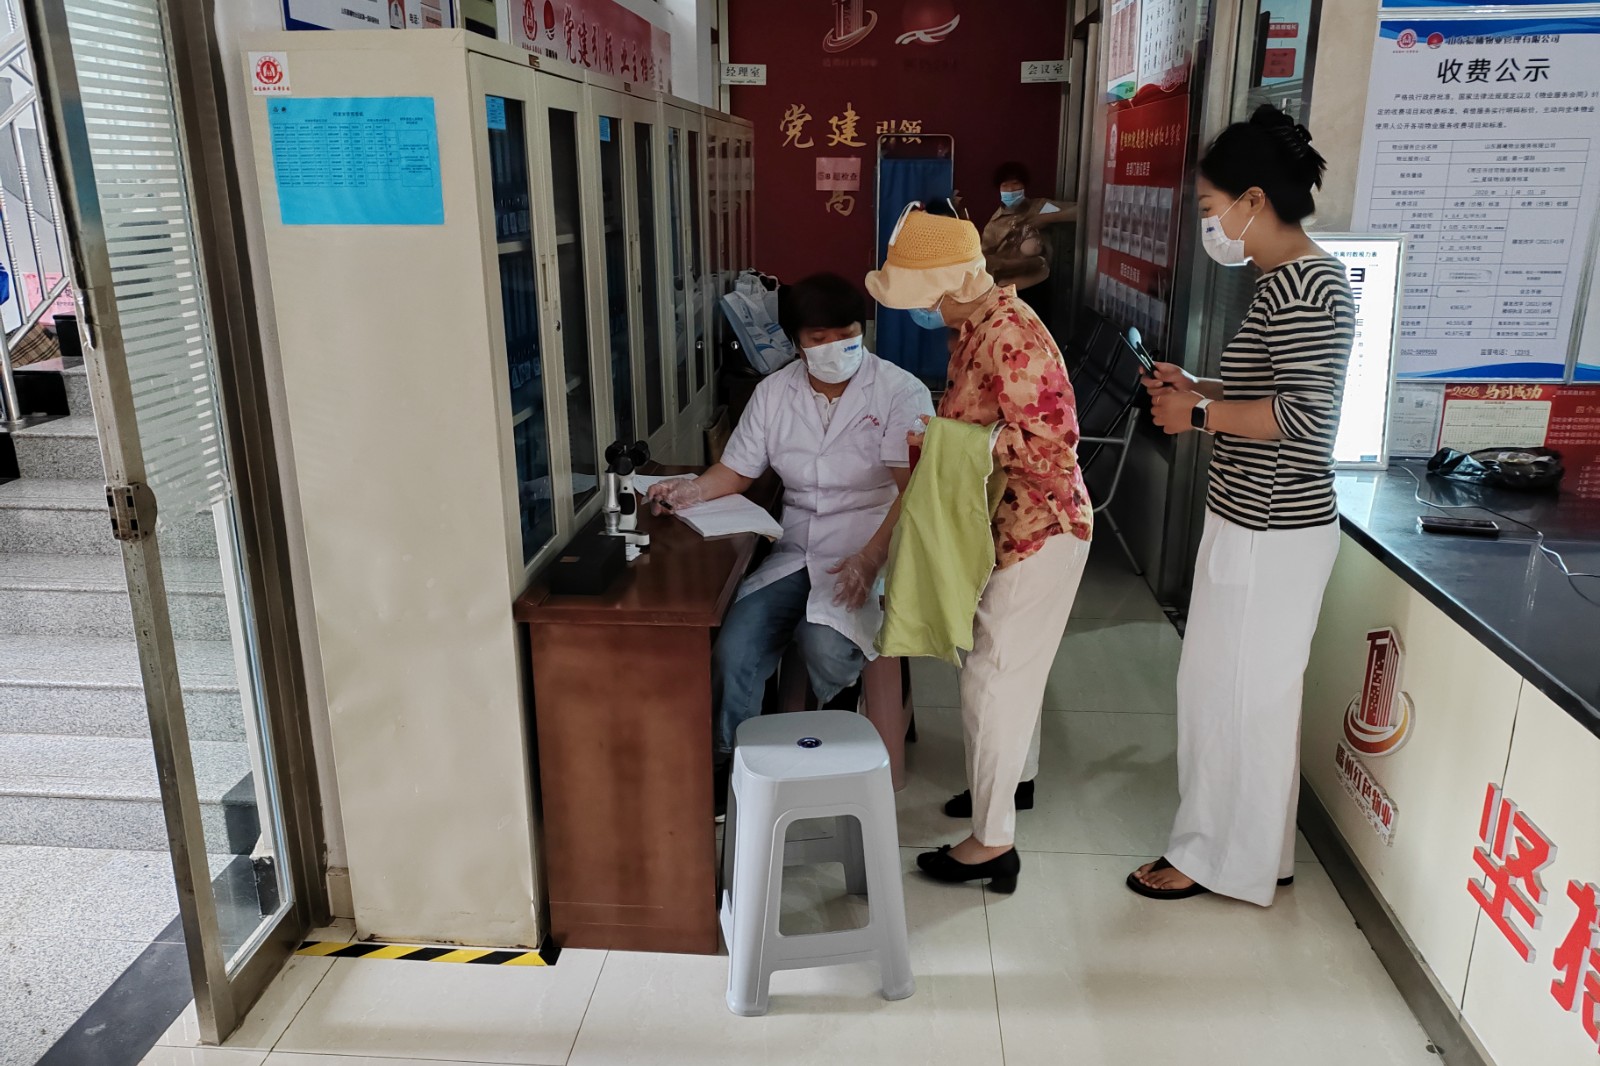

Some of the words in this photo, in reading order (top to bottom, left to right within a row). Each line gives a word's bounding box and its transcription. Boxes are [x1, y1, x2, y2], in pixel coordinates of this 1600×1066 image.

[726, 66, 761, 78] 经理室
[1026, 63, 1064, 75] 会议室
[1437, 58, 1550, 84] 收费公示
[779, 102, 923, 149] 党建引领
[1450, 386, 1480, 397] 2026
[1483, 384, 1543, 399] 马到成功
